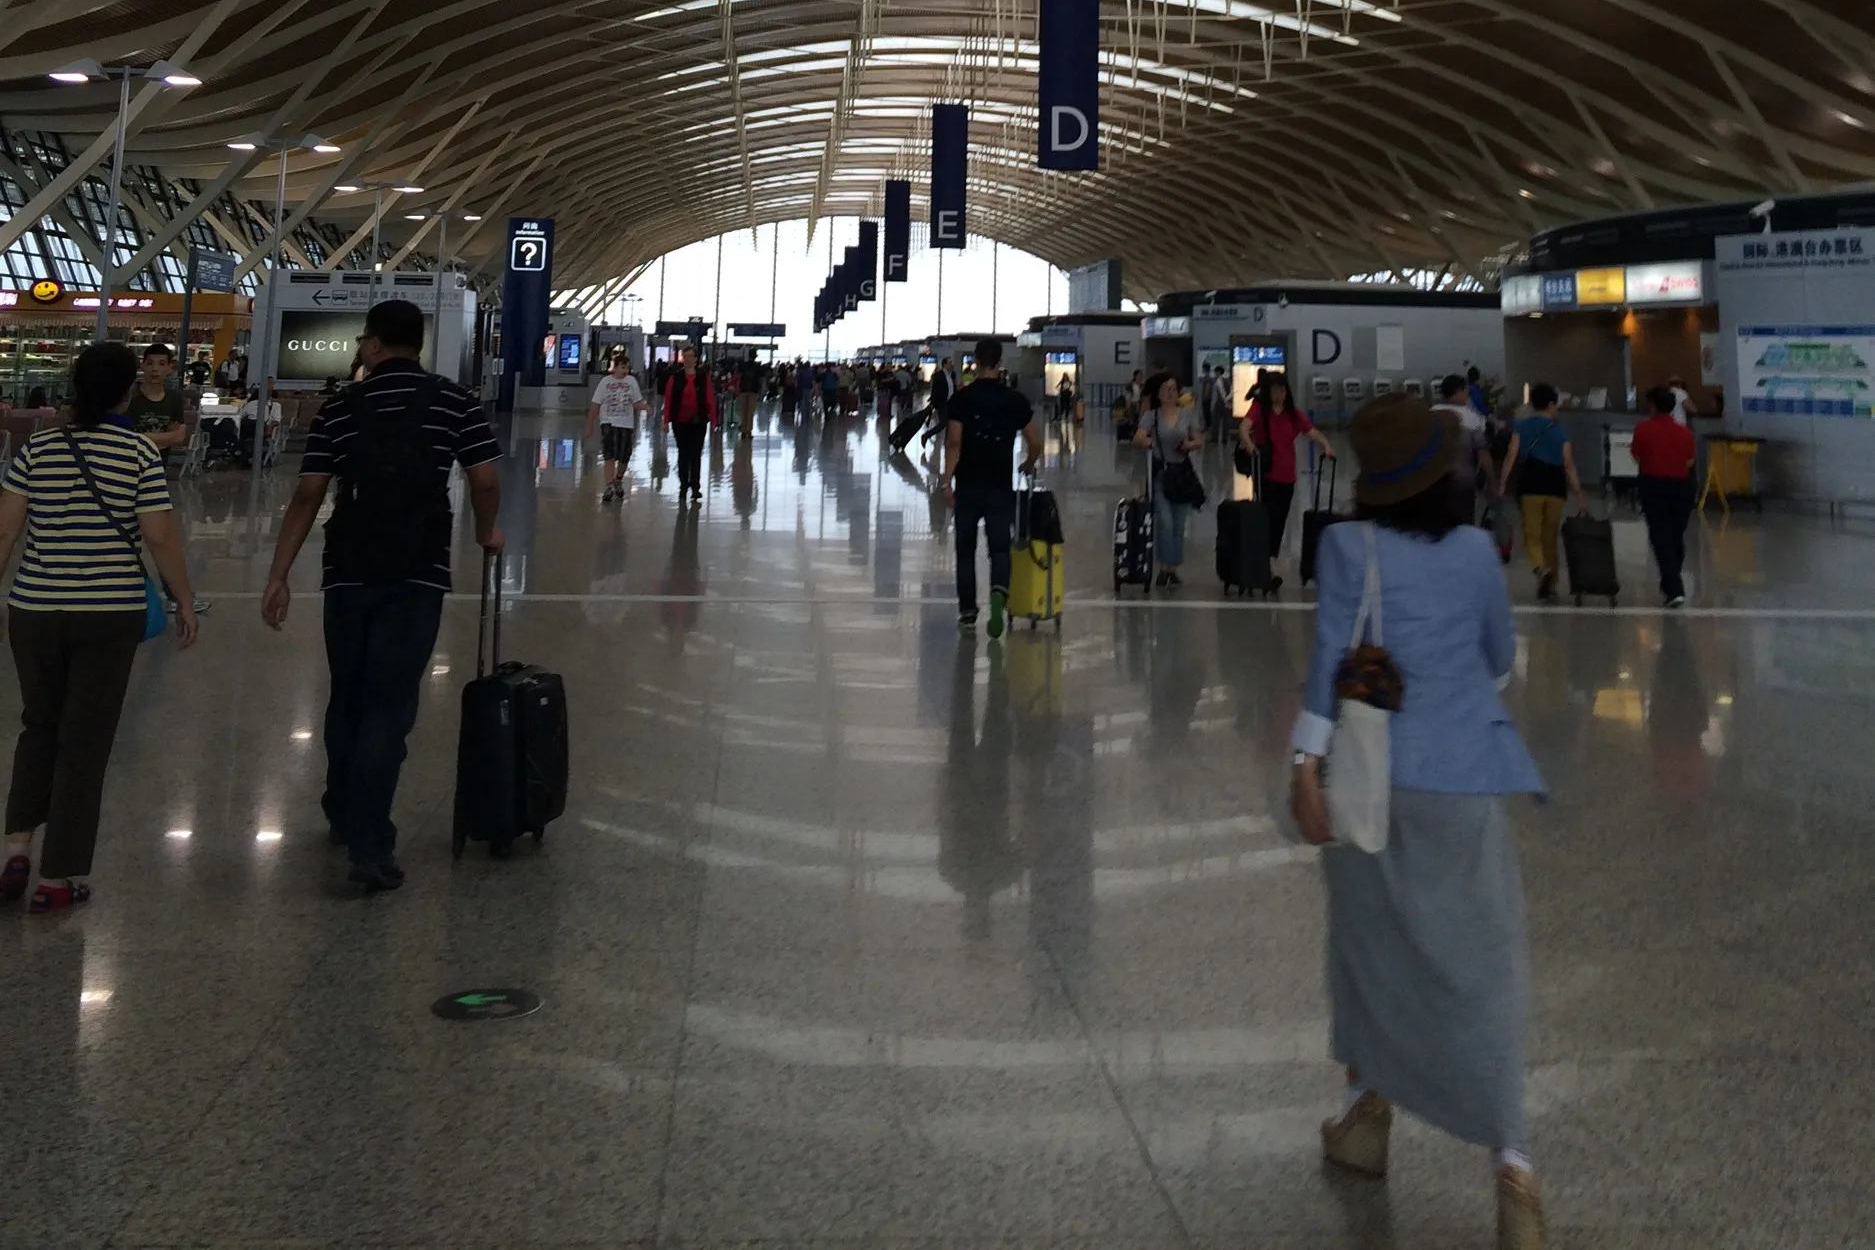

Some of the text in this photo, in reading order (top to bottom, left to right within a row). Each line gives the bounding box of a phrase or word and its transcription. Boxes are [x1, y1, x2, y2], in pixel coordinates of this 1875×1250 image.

[1051, 105, 1089, 151] D
[937, 210, 958, 239] E
[888, 254, 904, 276] F
[859, 279, 874, 297] G
[834, 303, 842, 317] J
[844, 293, 857, 308] H
[1253, 306, 1264, 323] D
[287, 339, 348, 352] GUCCI
[1114, 341, 1131, 365] E
[1312, 328, 1342, 365] D
